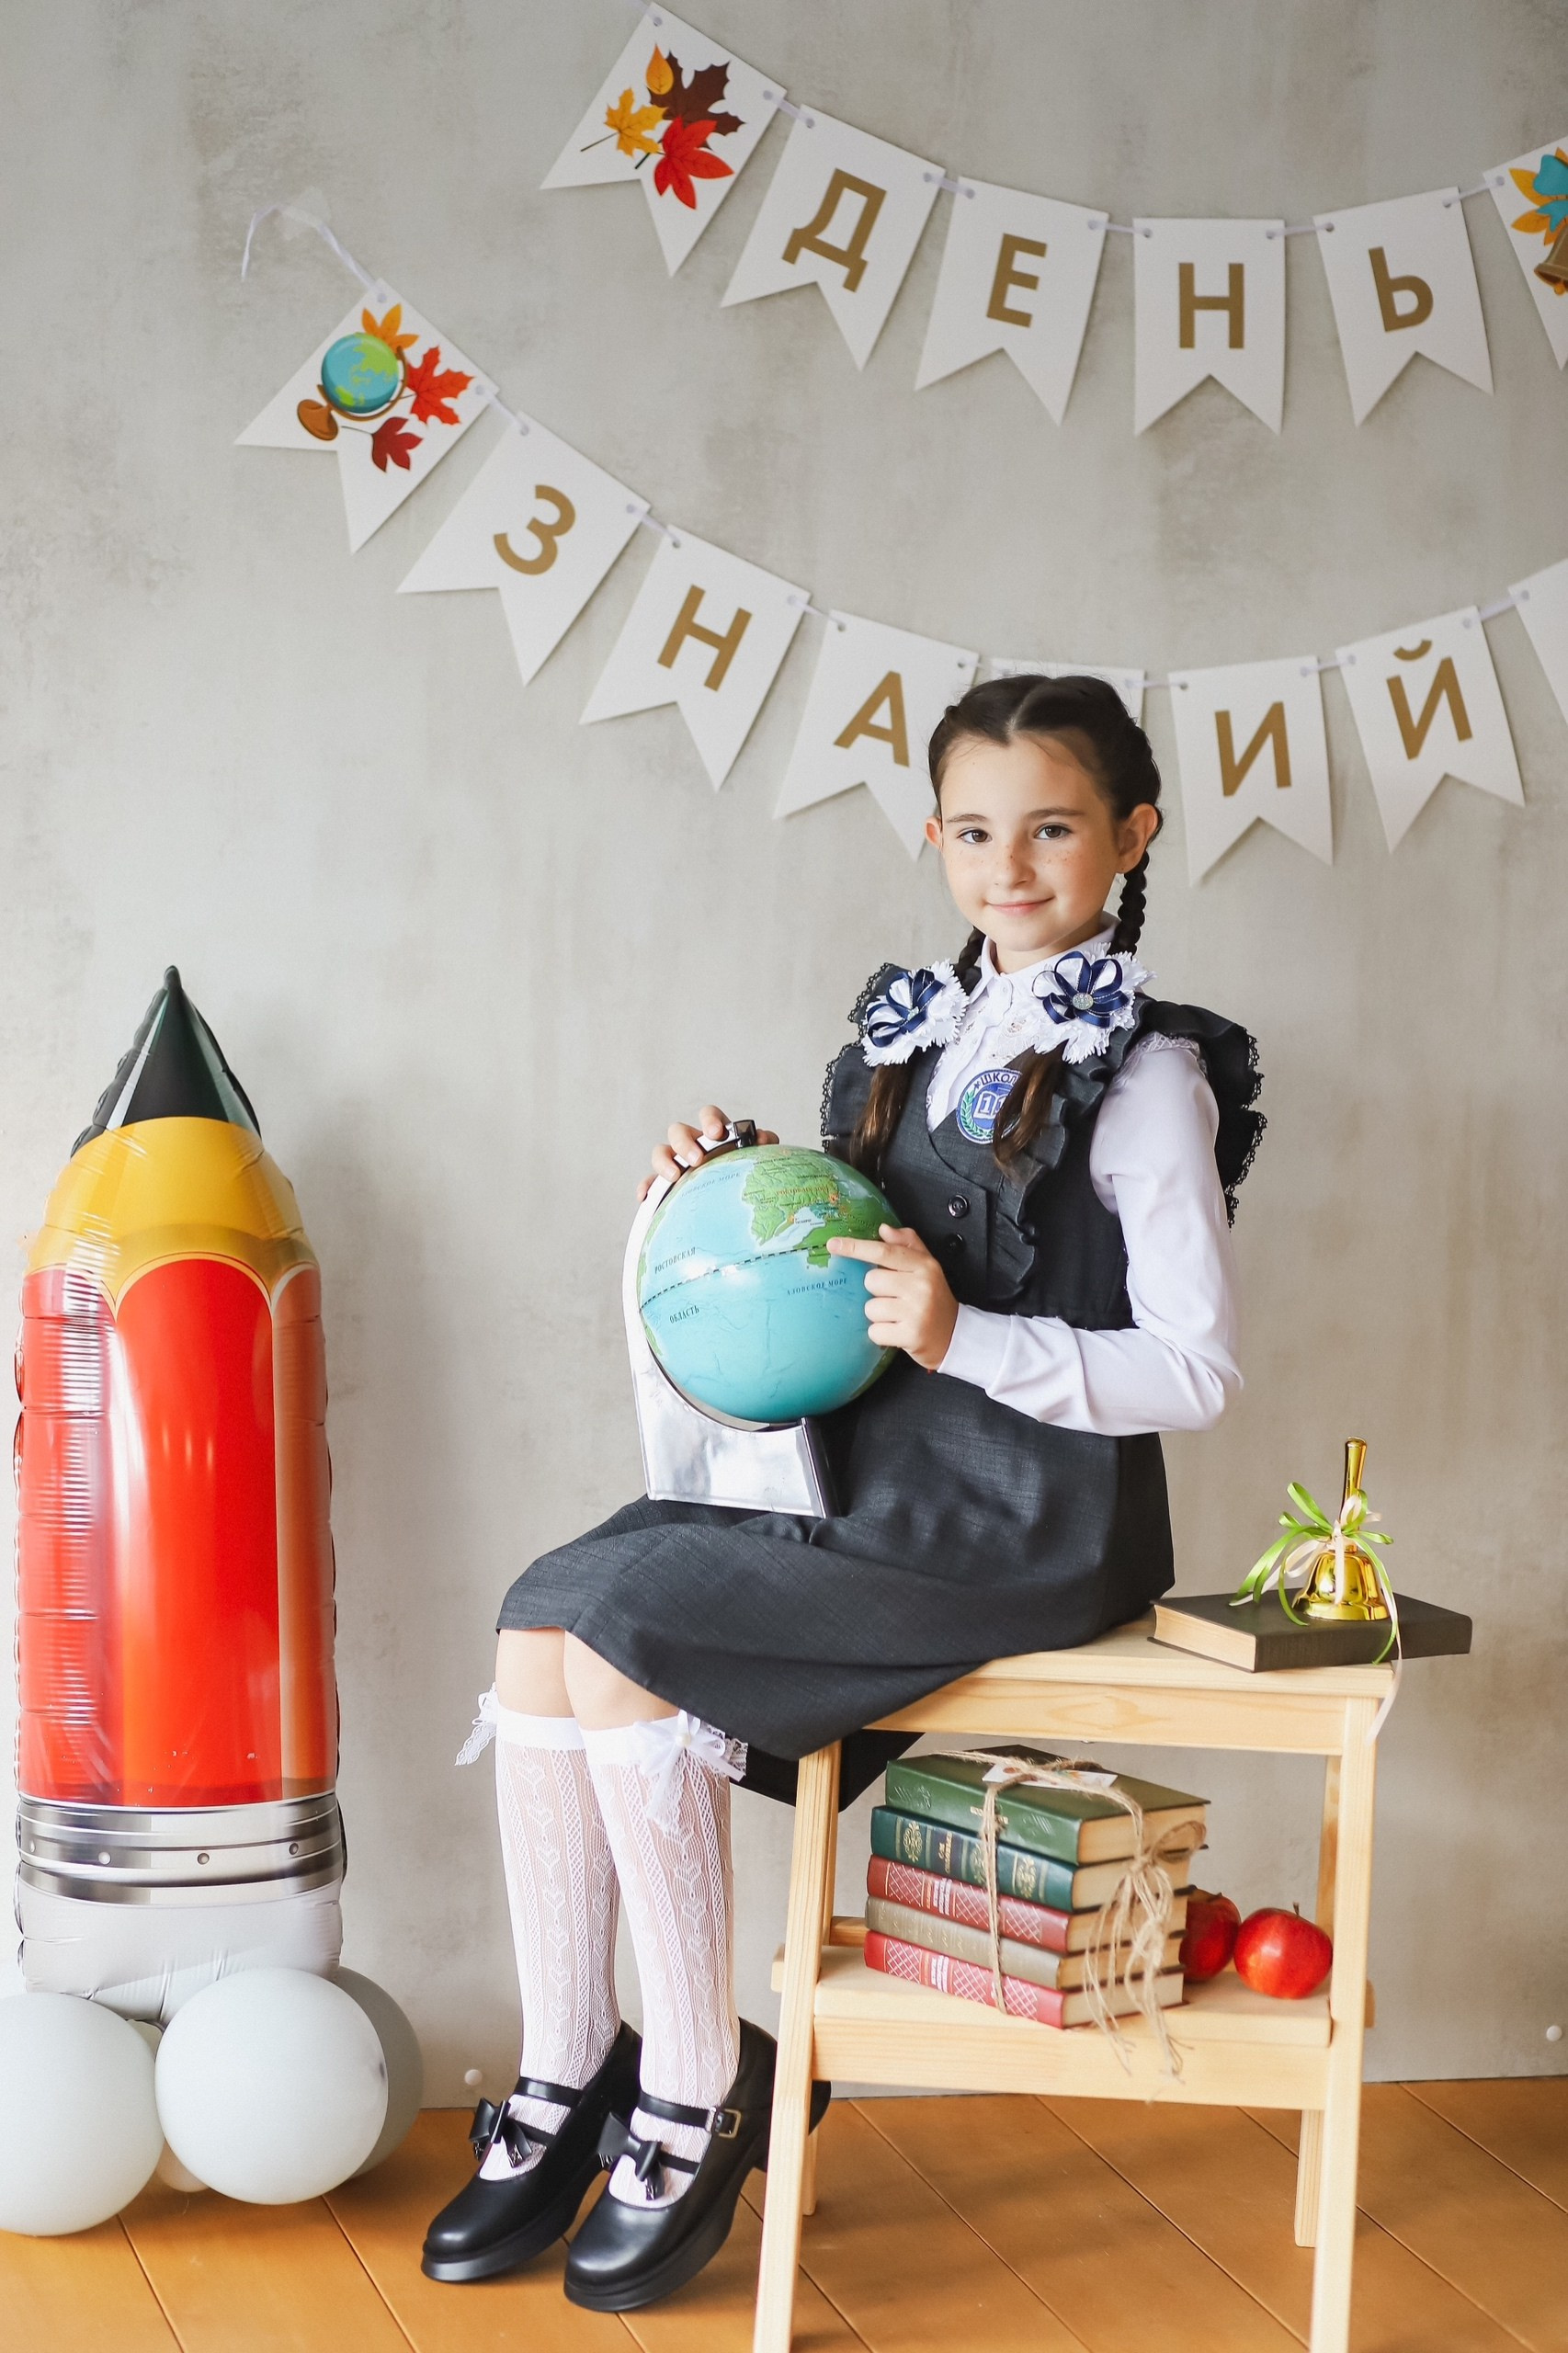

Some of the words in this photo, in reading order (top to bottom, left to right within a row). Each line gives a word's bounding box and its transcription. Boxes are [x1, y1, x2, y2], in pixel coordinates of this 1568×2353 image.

[782, 170, 1434, 350] ДЕНЬ
[493, 483, 1473, 799] ЗНАИЙ
[980, 1071, 1018, 1086] ШКОЛ
[653, 1245, 696, 1275] РОСТОВСКАЯ
[669, 1304, 699, 1324] ОБЛАСТЬ
